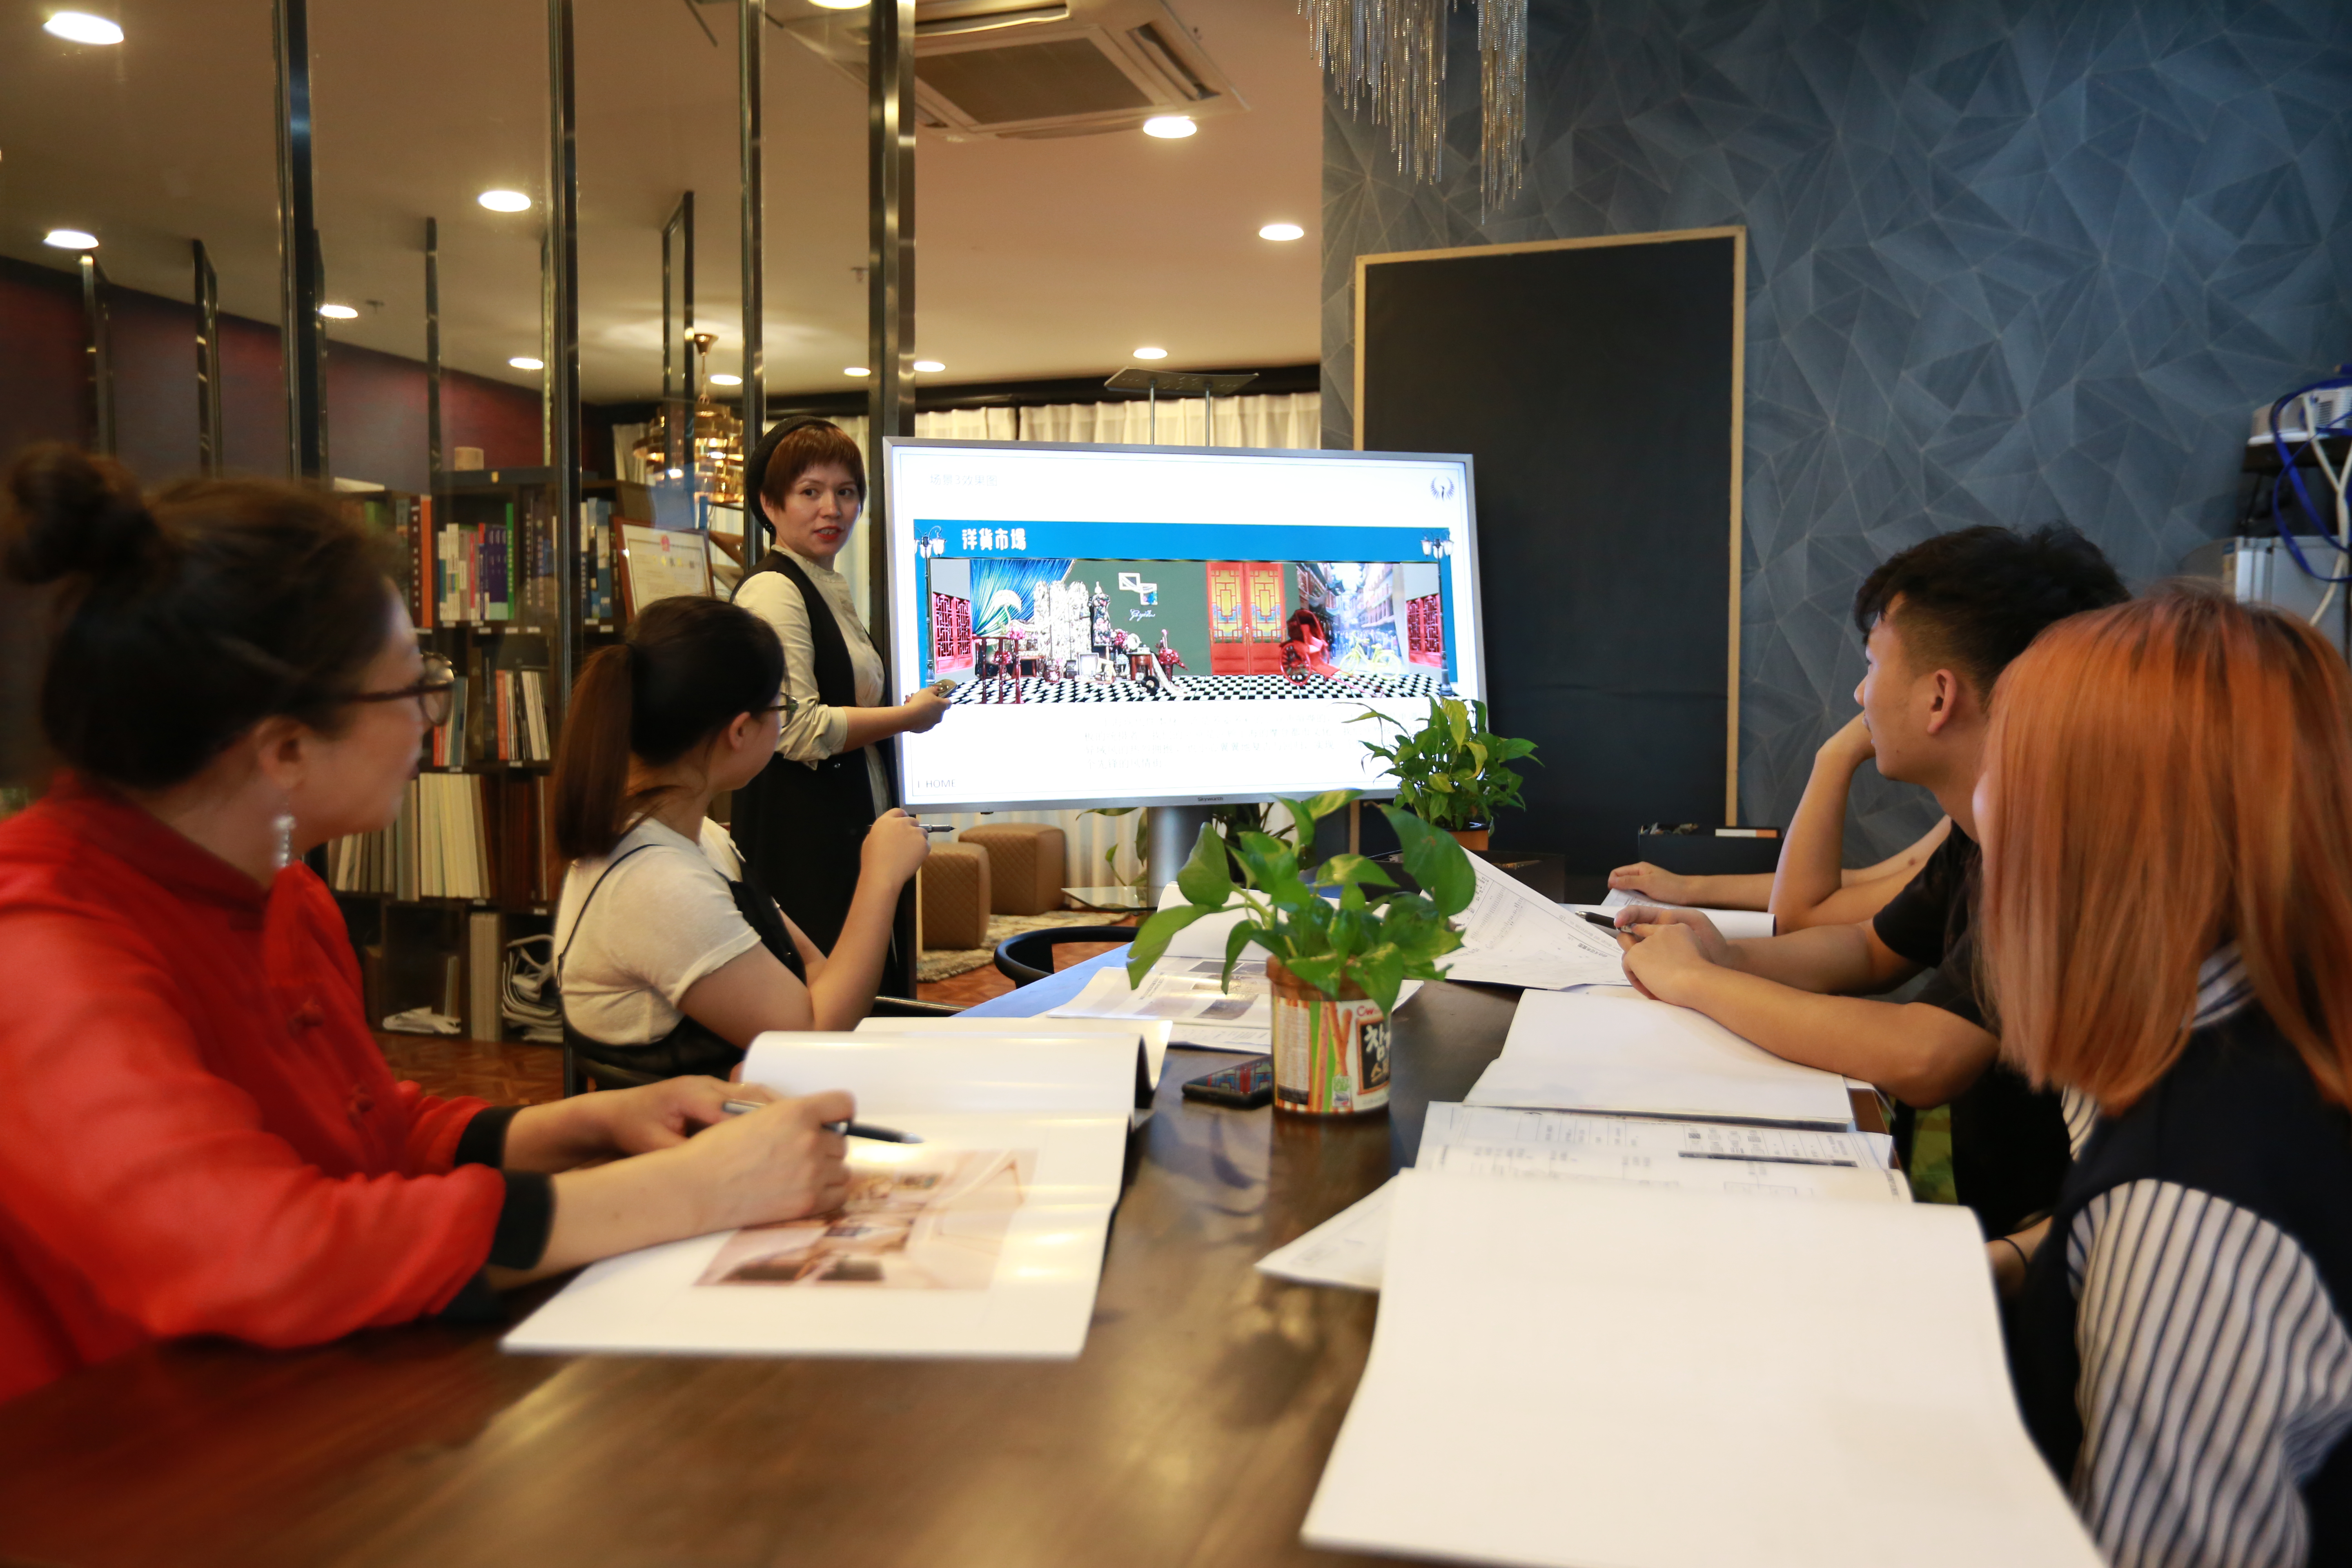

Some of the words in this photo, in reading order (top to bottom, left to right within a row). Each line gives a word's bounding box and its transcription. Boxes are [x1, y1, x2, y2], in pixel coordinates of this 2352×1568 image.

[930, 474, 997, 486] 场景3效果图
[962, 528, 1027, 551] 洋貨市場
[926, 779, 956, 788] HOME
